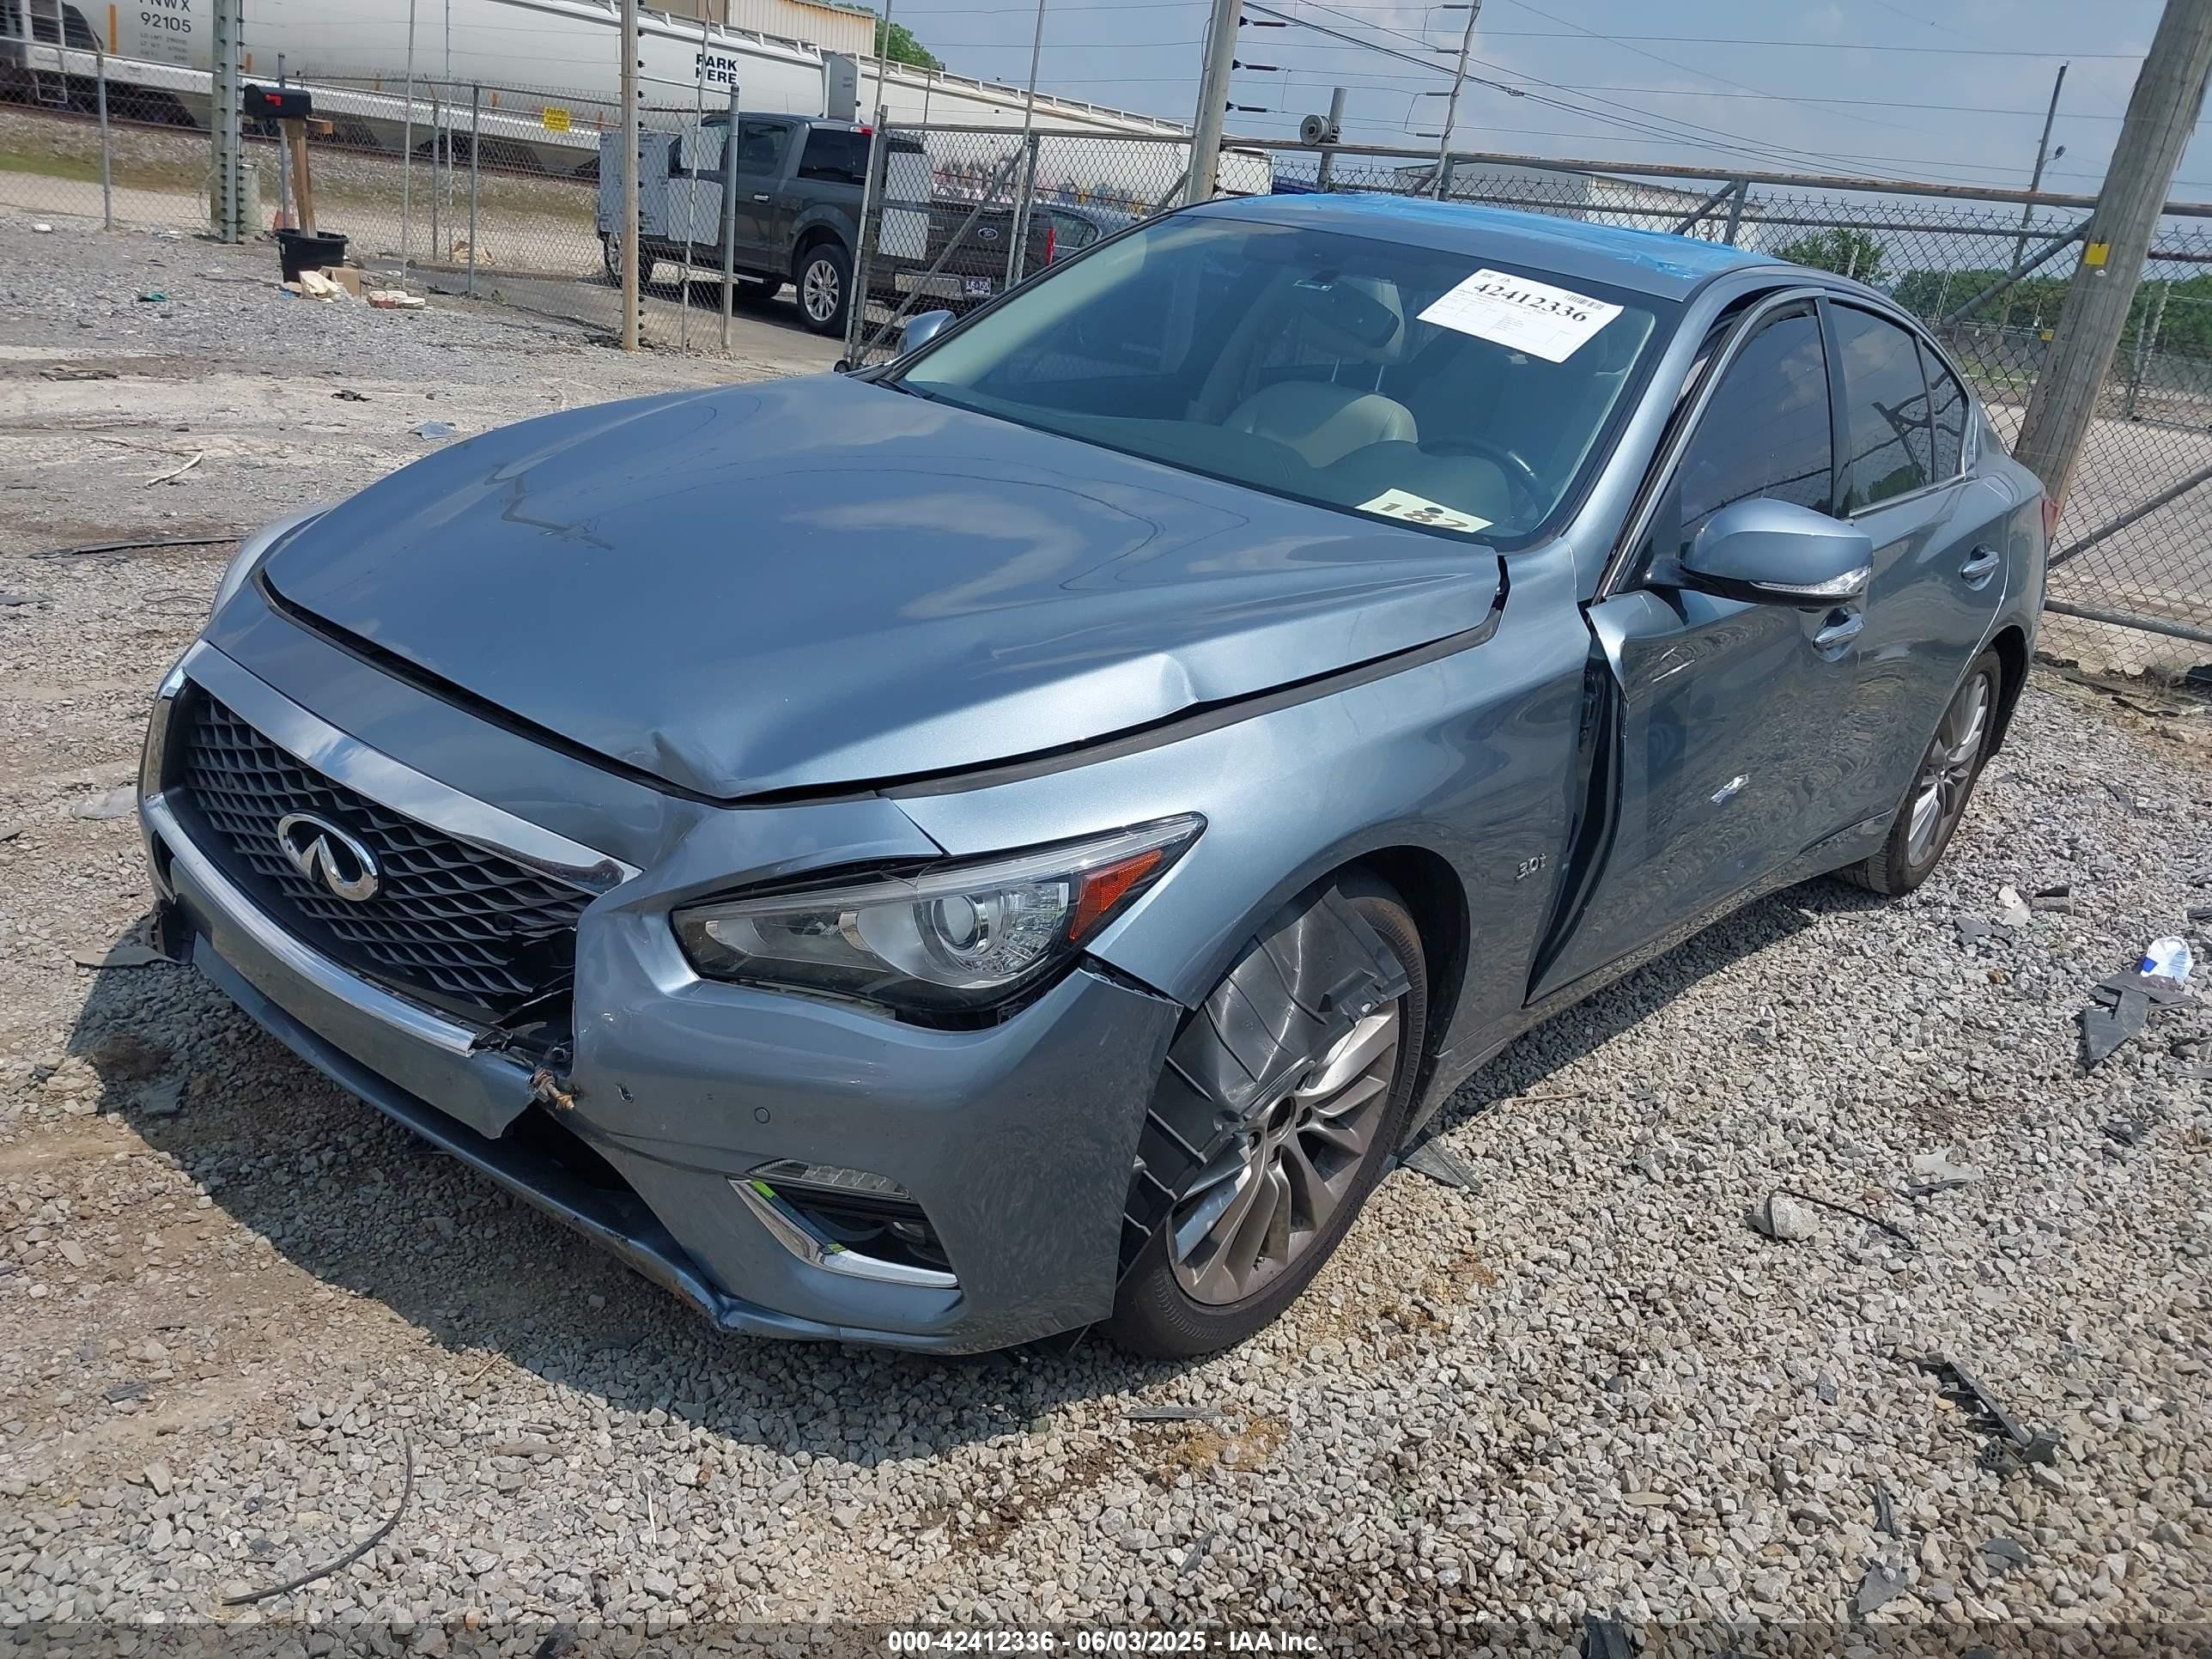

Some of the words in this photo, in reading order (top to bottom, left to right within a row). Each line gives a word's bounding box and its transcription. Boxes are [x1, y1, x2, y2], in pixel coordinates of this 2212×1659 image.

[140, 0, 191, 12] WX
[140, 11, 192, 33] 92105
[696, 53, 738, 72] PARK
[1474, 283, 1594, 322] 42412336
